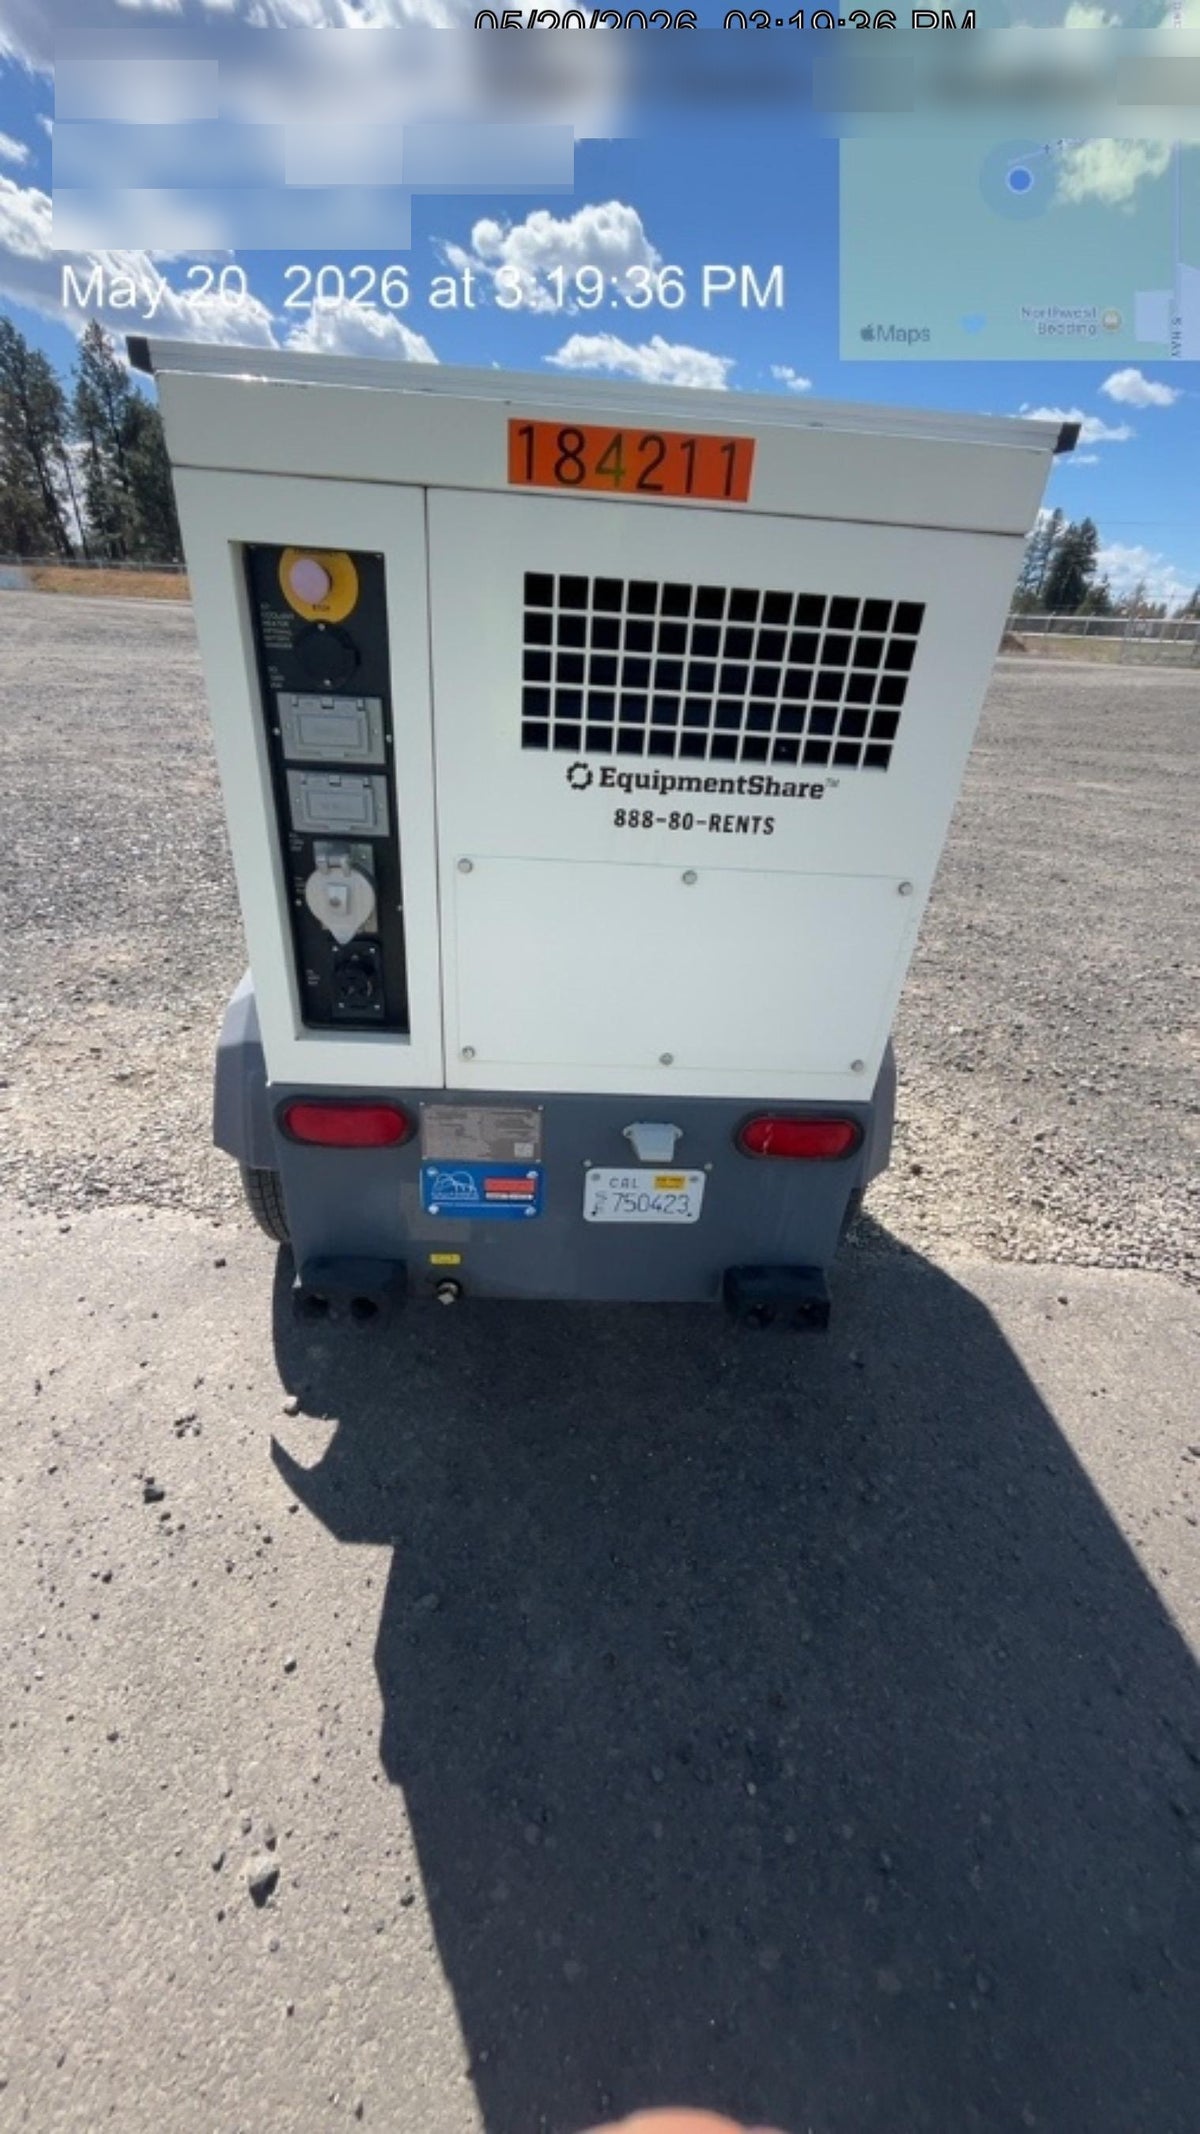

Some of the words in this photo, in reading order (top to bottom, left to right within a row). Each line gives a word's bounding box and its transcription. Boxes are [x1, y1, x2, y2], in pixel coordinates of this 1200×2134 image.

[518, 425, 738, 497] 184211
[599, 766, 825, 800] EquipmentShare
[613, 808, 775, 836] 888-80-RENTS
[608, 1177, 639, 1189] CAL
[612, 1191, 691, 1214] 750423
